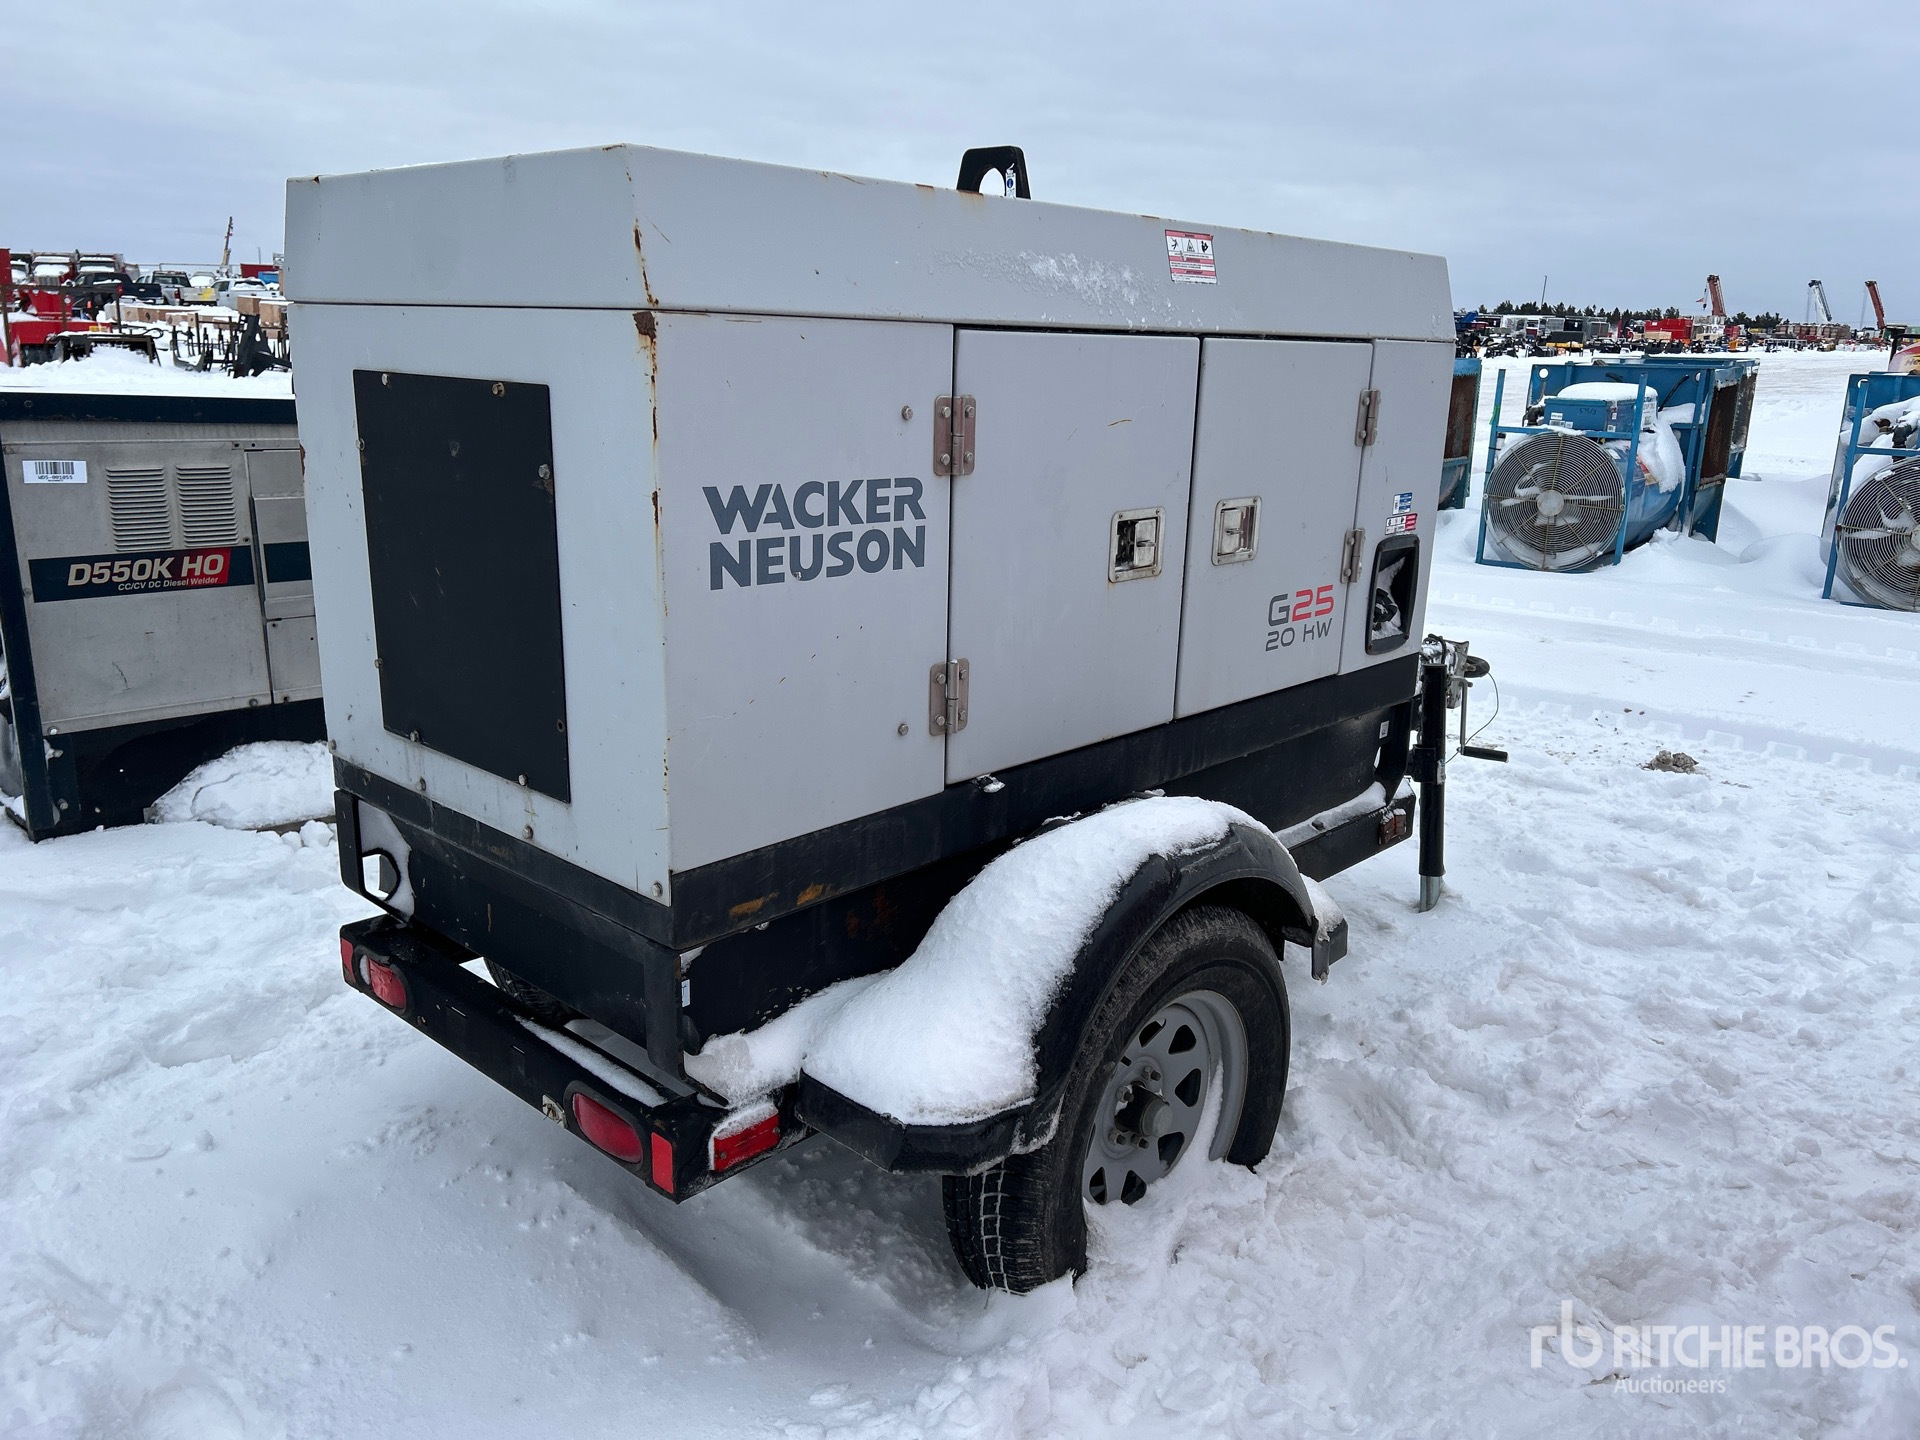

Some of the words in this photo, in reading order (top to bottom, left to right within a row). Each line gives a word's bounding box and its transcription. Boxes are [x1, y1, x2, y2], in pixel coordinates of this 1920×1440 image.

[702, 477, 927, 535] WACKER
[67, 557, 175, 586] D550K
[181, 554, 225, 578] HO
[709, 525, 926, 591] NEUSON
[118, 581, 146, 591] CC/CV
[148, 580, 162, 588] DC
[163, 578, 189, 588] Diesel
[190, 576, 219, 586] Welder
[1268, 584, 1335, 627] G25
[1265, 627, 1296, 652] 20
